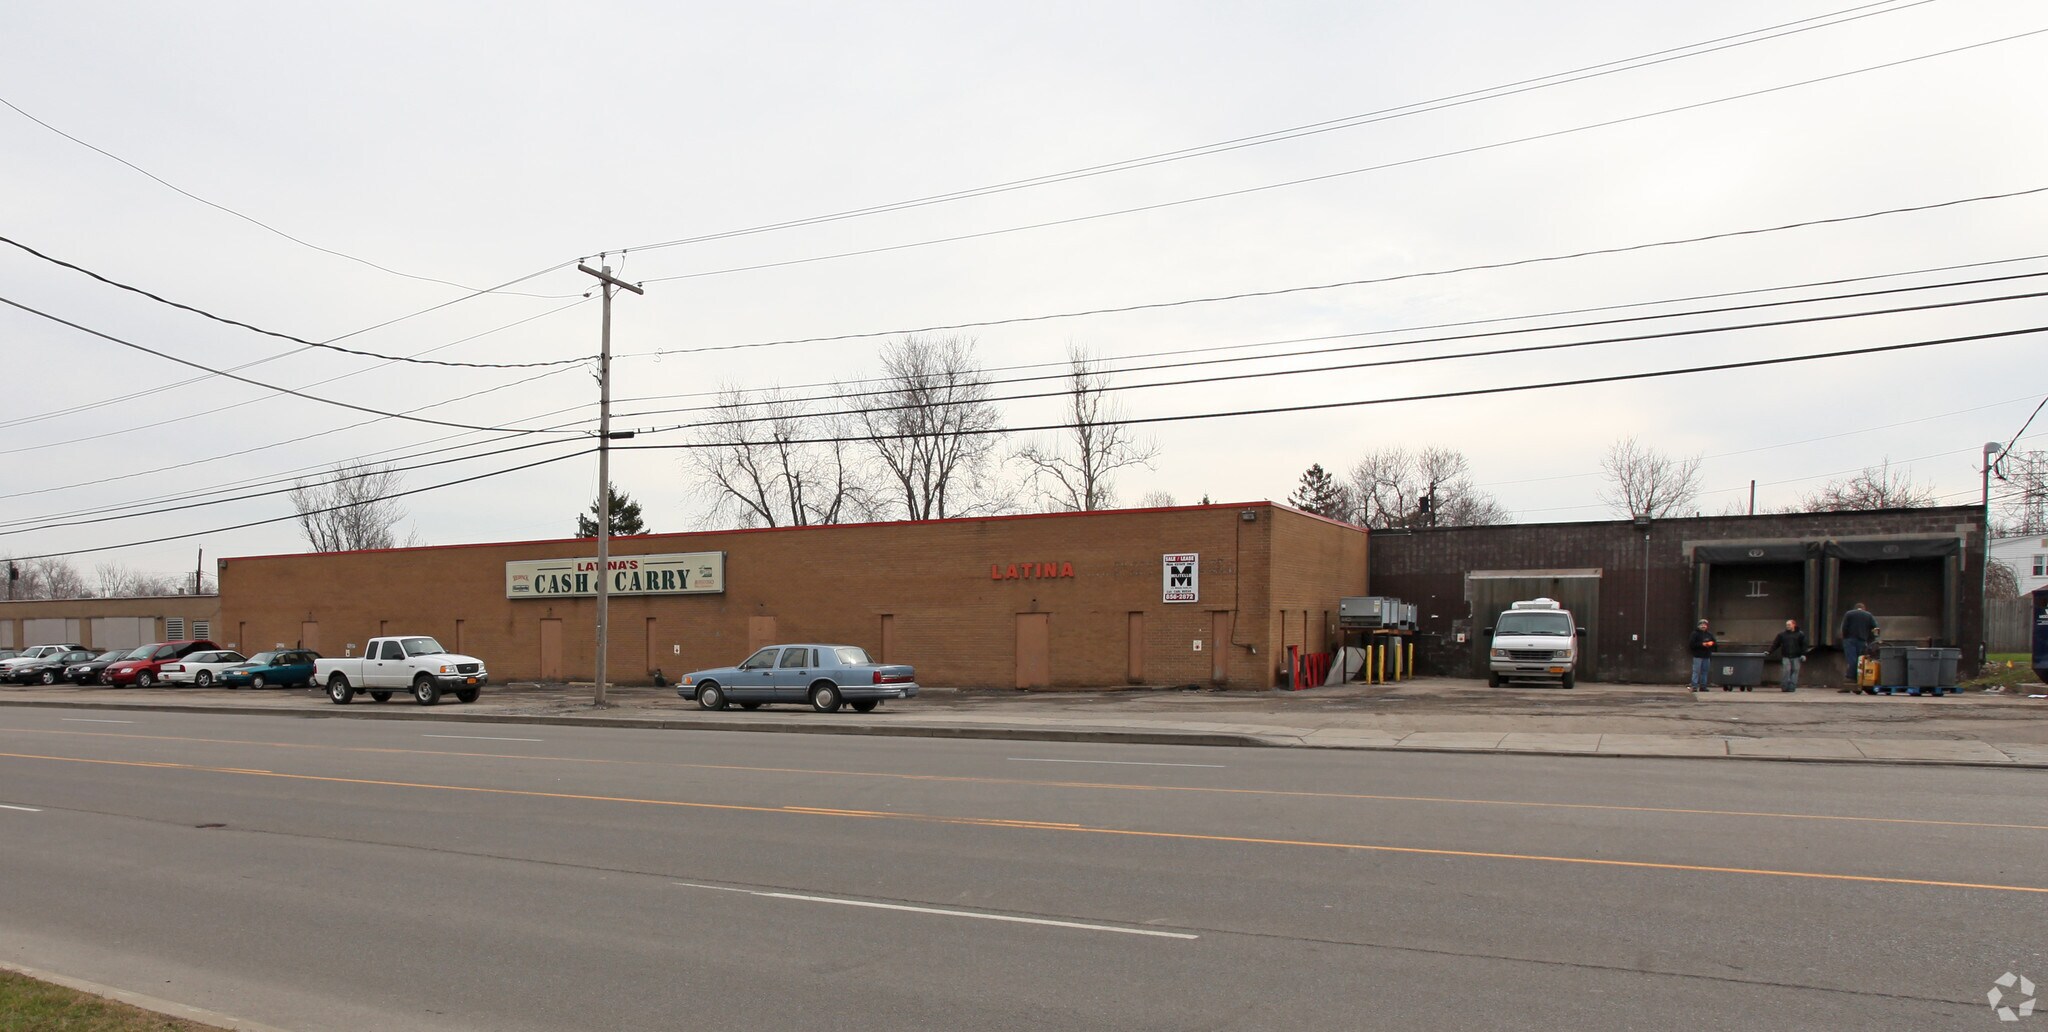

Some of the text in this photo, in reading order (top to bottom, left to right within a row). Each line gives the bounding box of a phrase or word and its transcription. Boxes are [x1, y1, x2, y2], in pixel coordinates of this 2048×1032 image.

[577, 560, 638, 571] LATNA'S
[991, 561, 1075, 580] LATINA
[534, 573, 588, 593] CASH
[615, 569, 690, 591] CARRY
